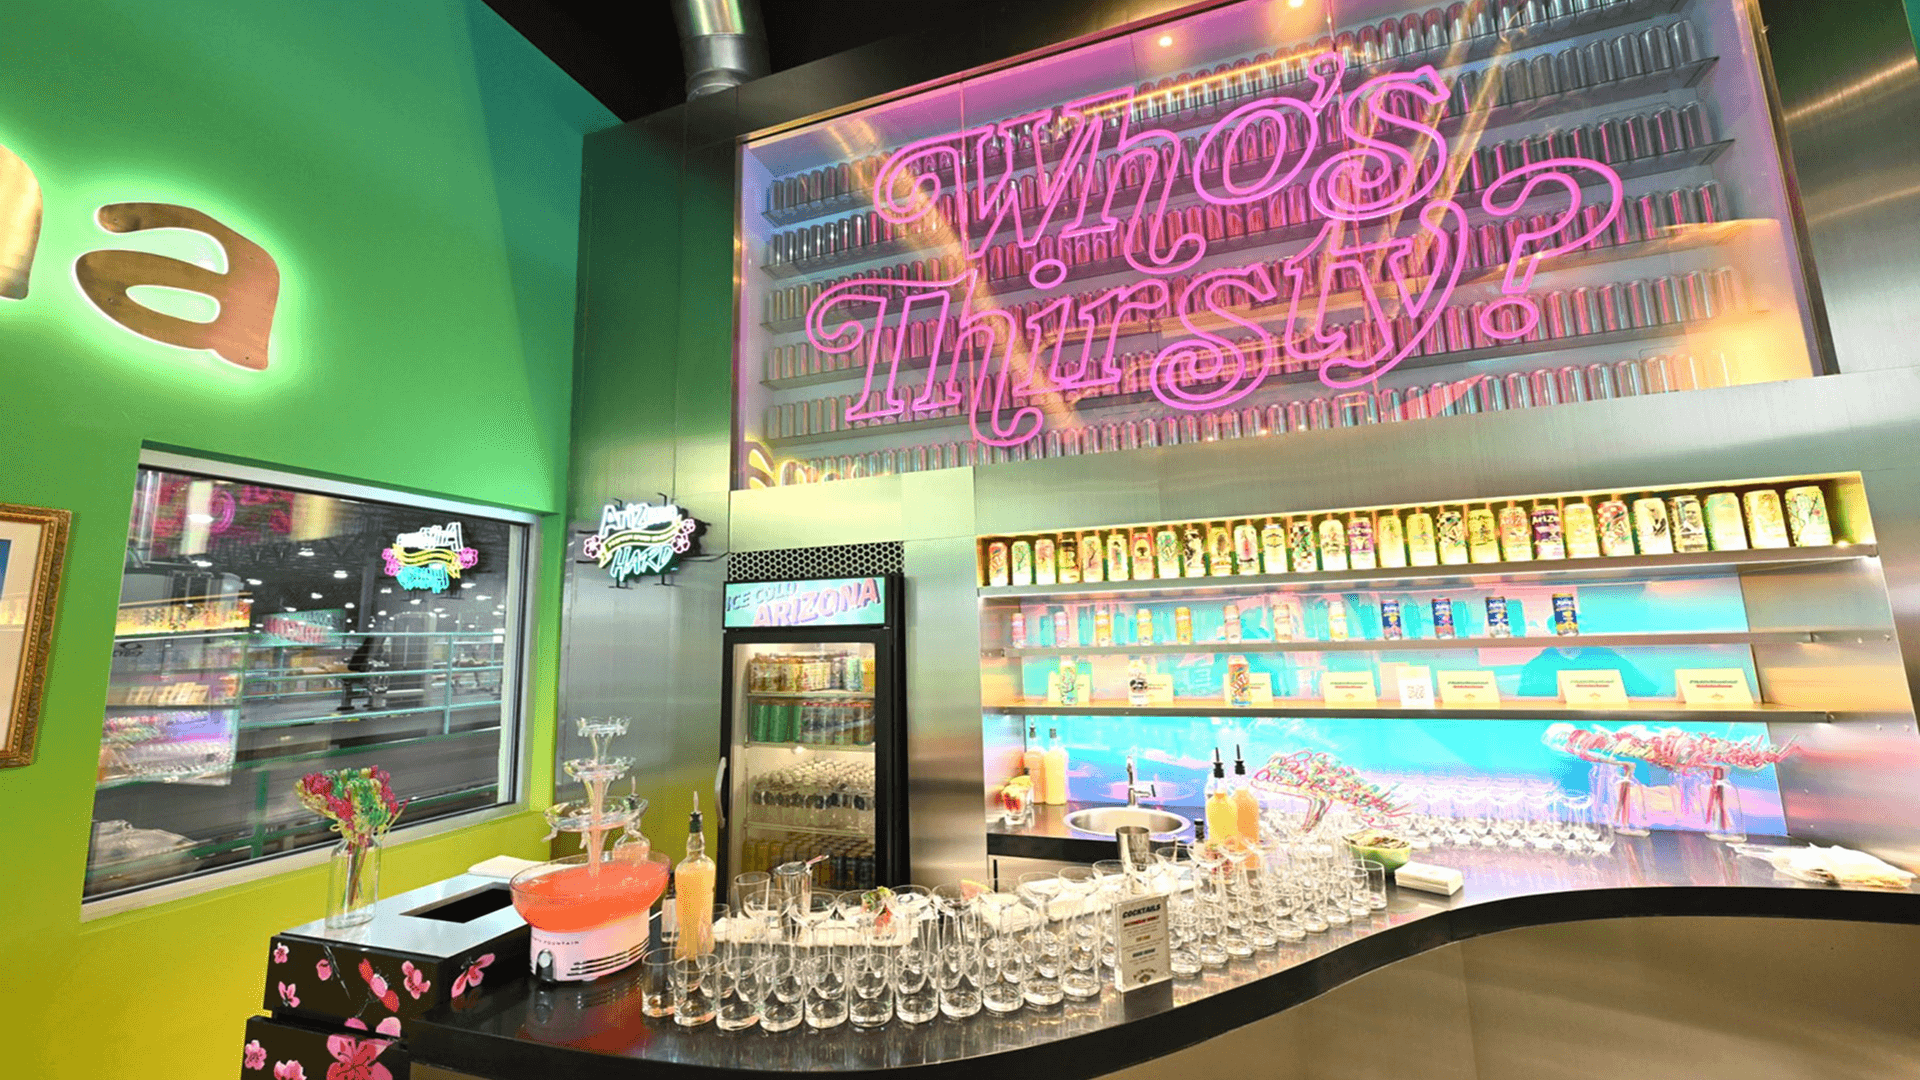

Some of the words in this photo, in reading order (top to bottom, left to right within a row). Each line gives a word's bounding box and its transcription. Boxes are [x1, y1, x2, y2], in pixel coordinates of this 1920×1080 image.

[873, 51, 1452, 274] Who's
[806, 157, 1623, 447] Thirsty?
[726, 591, 751, 612] ICE
[754, 577, 881, 627] ARIZONA
[1122, 903, 1161, 919] COCKTAILS
